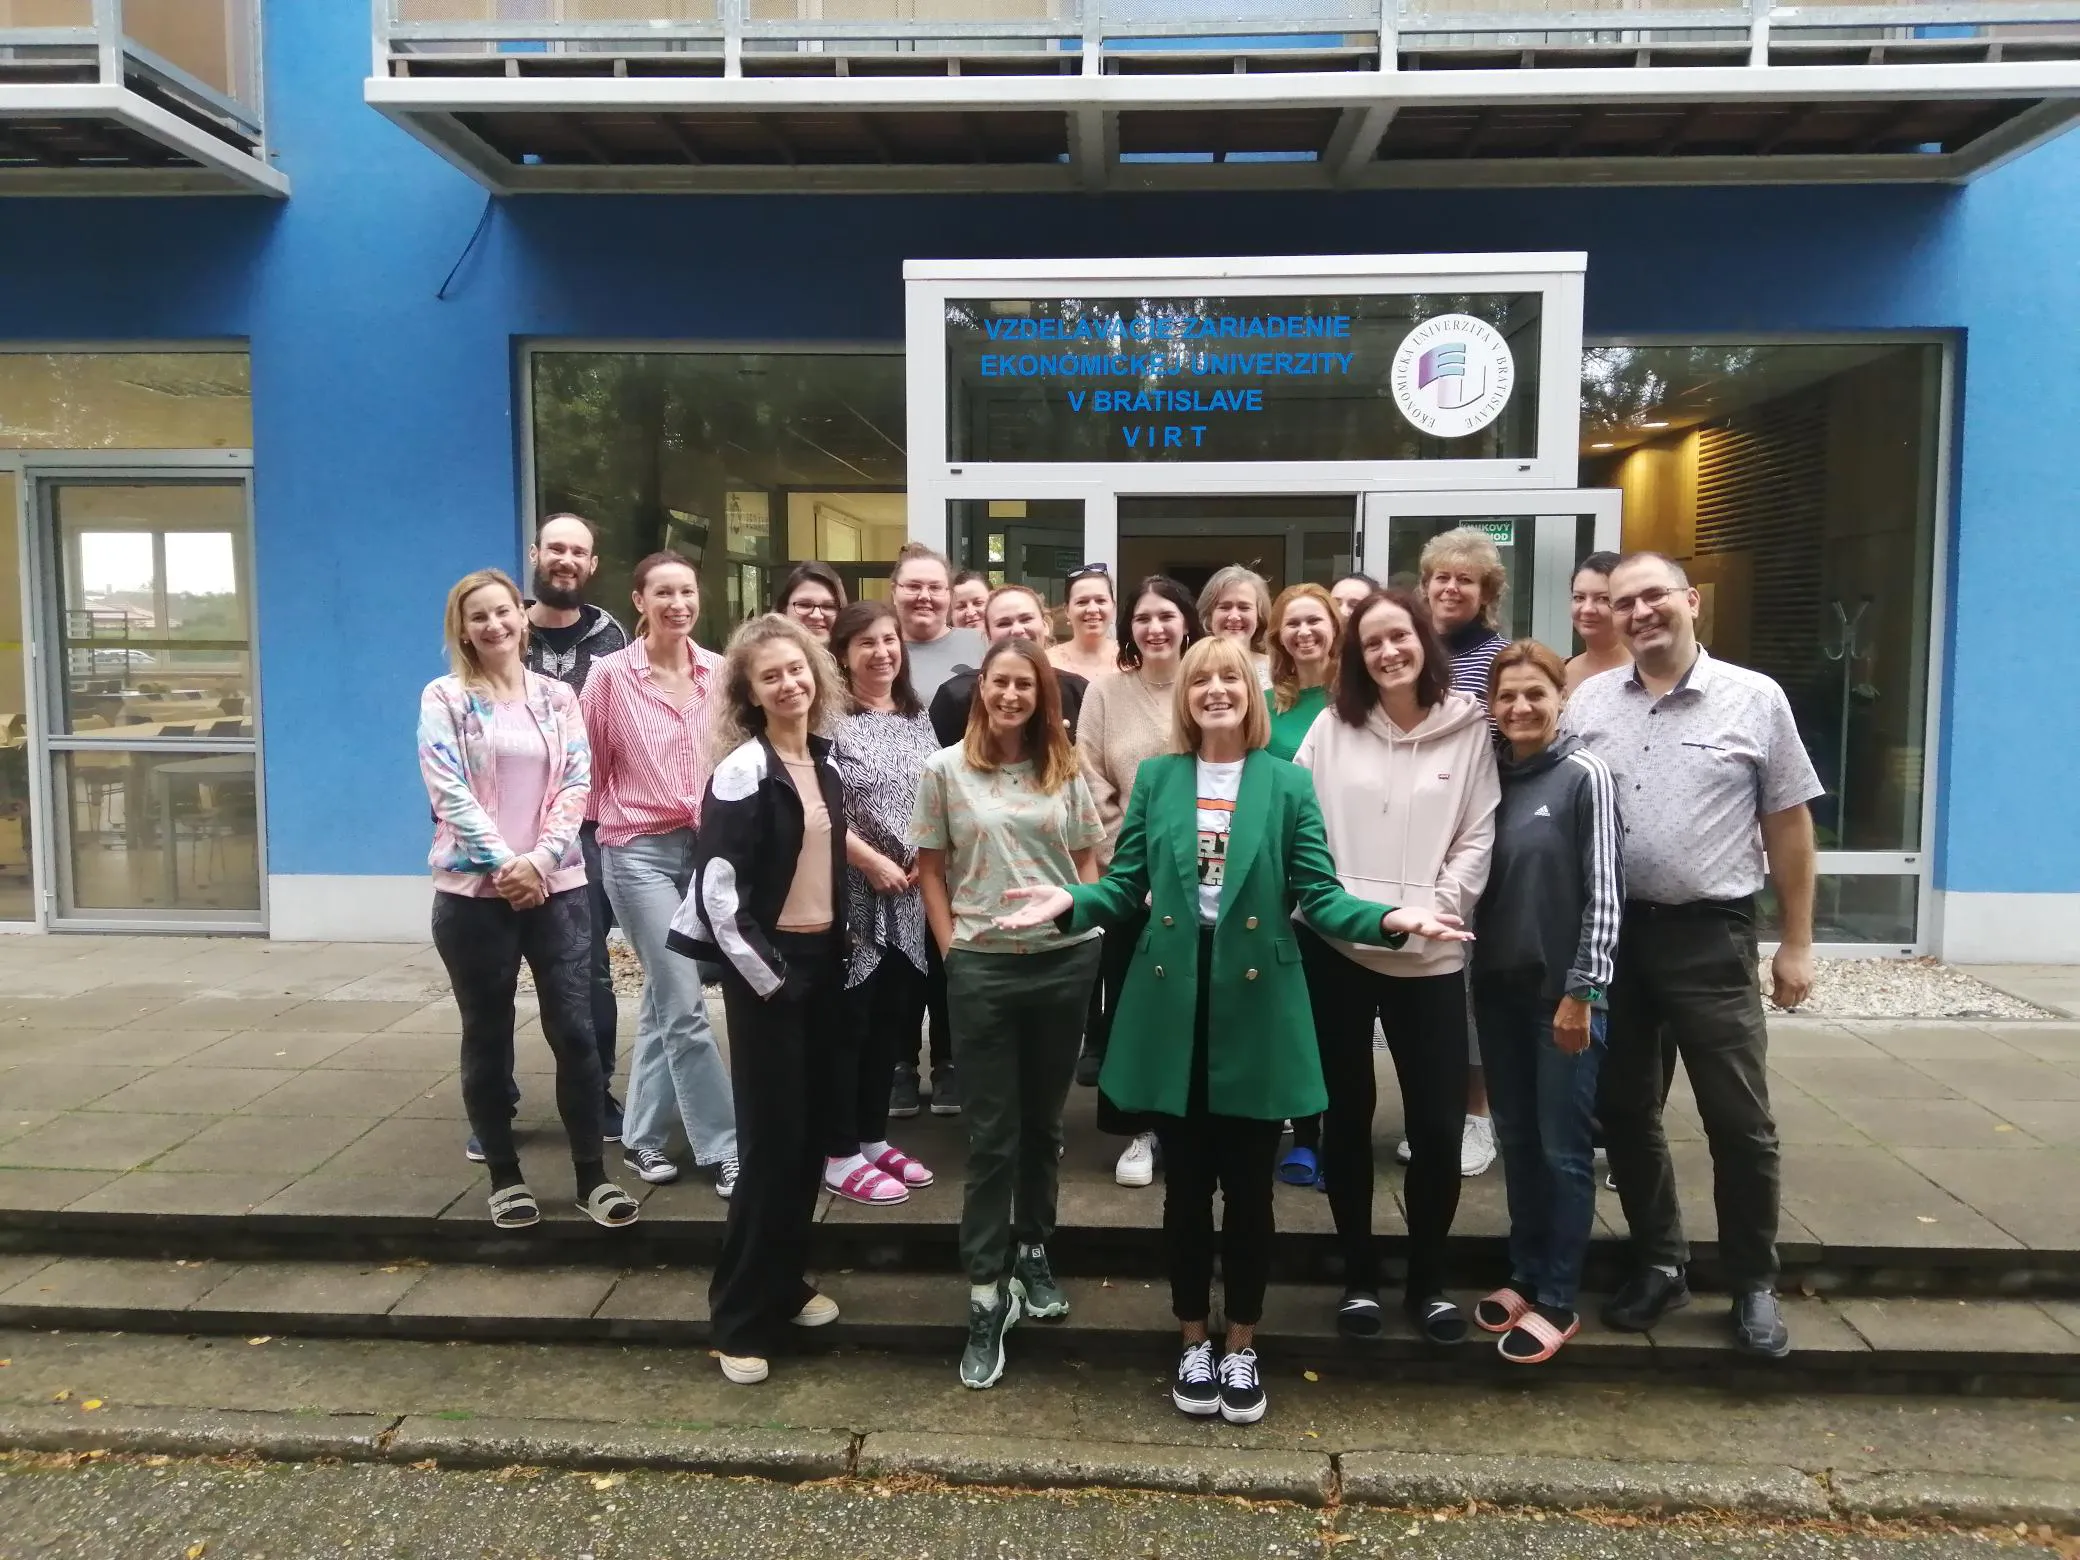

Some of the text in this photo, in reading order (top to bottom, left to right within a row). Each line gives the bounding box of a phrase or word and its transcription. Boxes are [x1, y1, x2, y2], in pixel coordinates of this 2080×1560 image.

[984, 313, 1351, 341] VZDELÁVACIE ZARIADENIE
[981, 352, 1354, 376] EKONOMICKEJ UNIVERZITY
[1412, 320, 1491, 346] UNIVERZITA
[1464, 356, 1509, 430] BRATISLAVE
[1067, 389, 1263, 412] V BRATISLAVE
